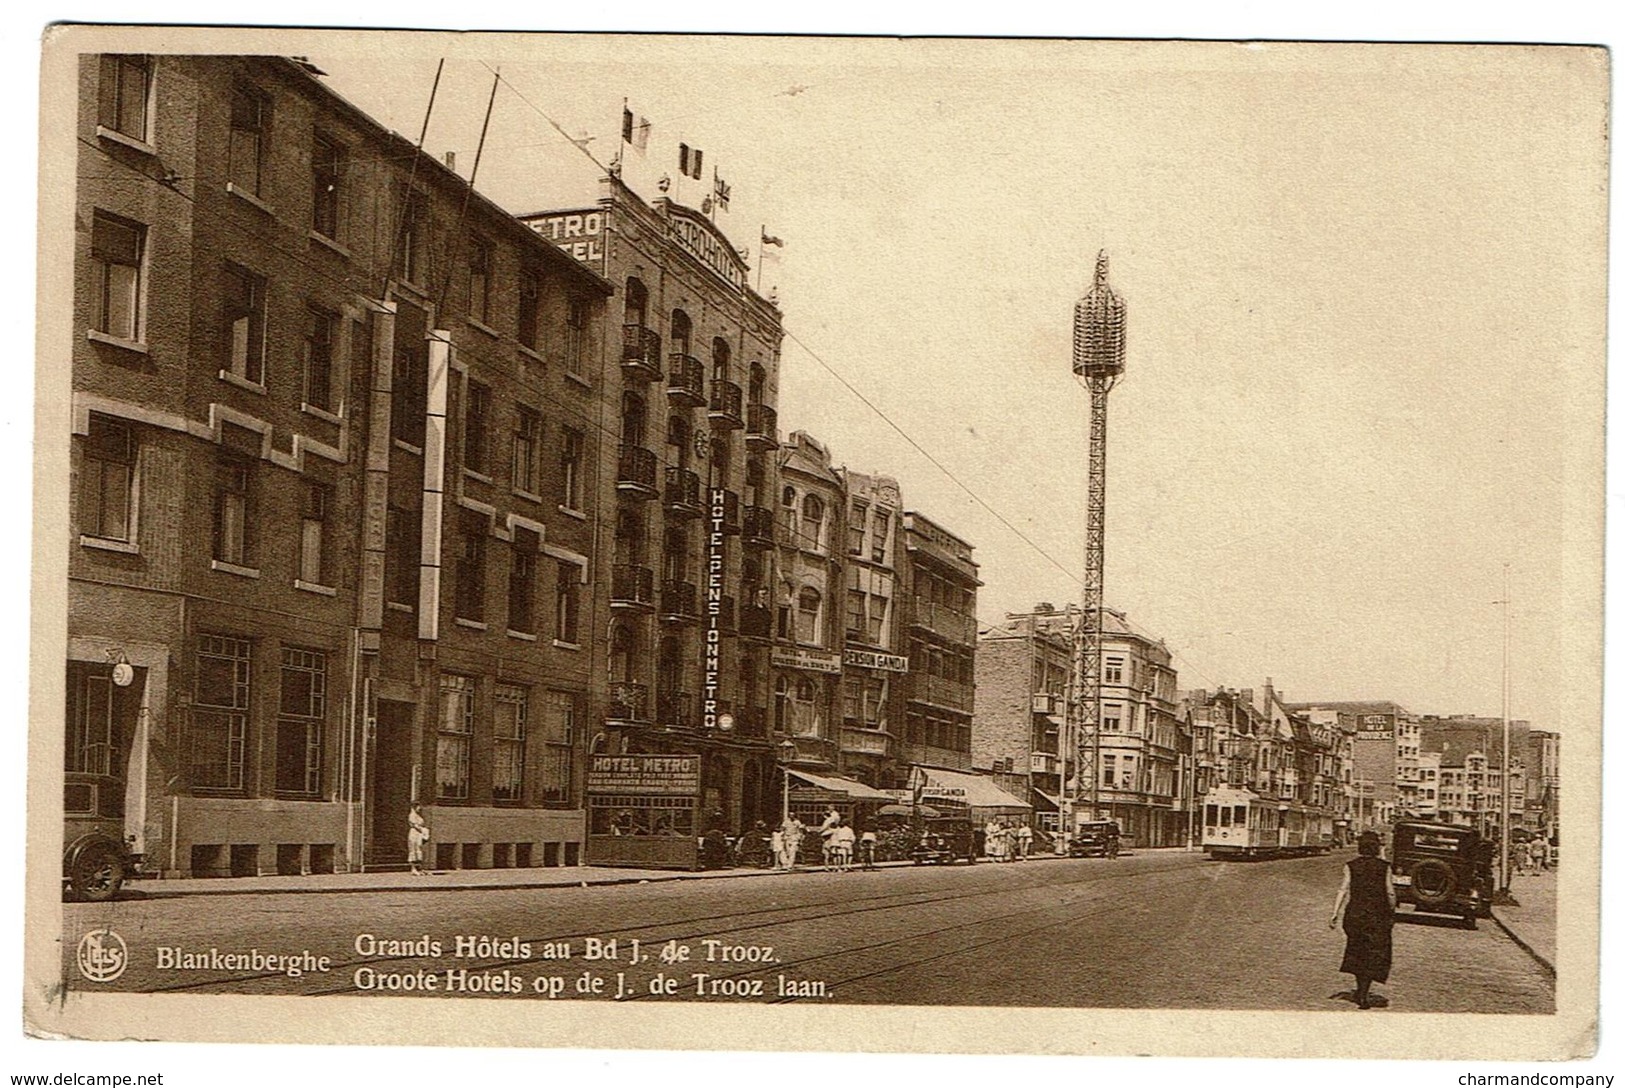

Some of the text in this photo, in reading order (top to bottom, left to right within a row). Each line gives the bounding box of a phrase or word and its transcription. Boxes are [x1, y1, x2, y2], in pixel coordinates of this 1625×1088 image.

[521, 213, 601, 240] ETRO
[877, 654, 908, 672] GANDA
[593, 757, 690, 773] HOTEL METRO
